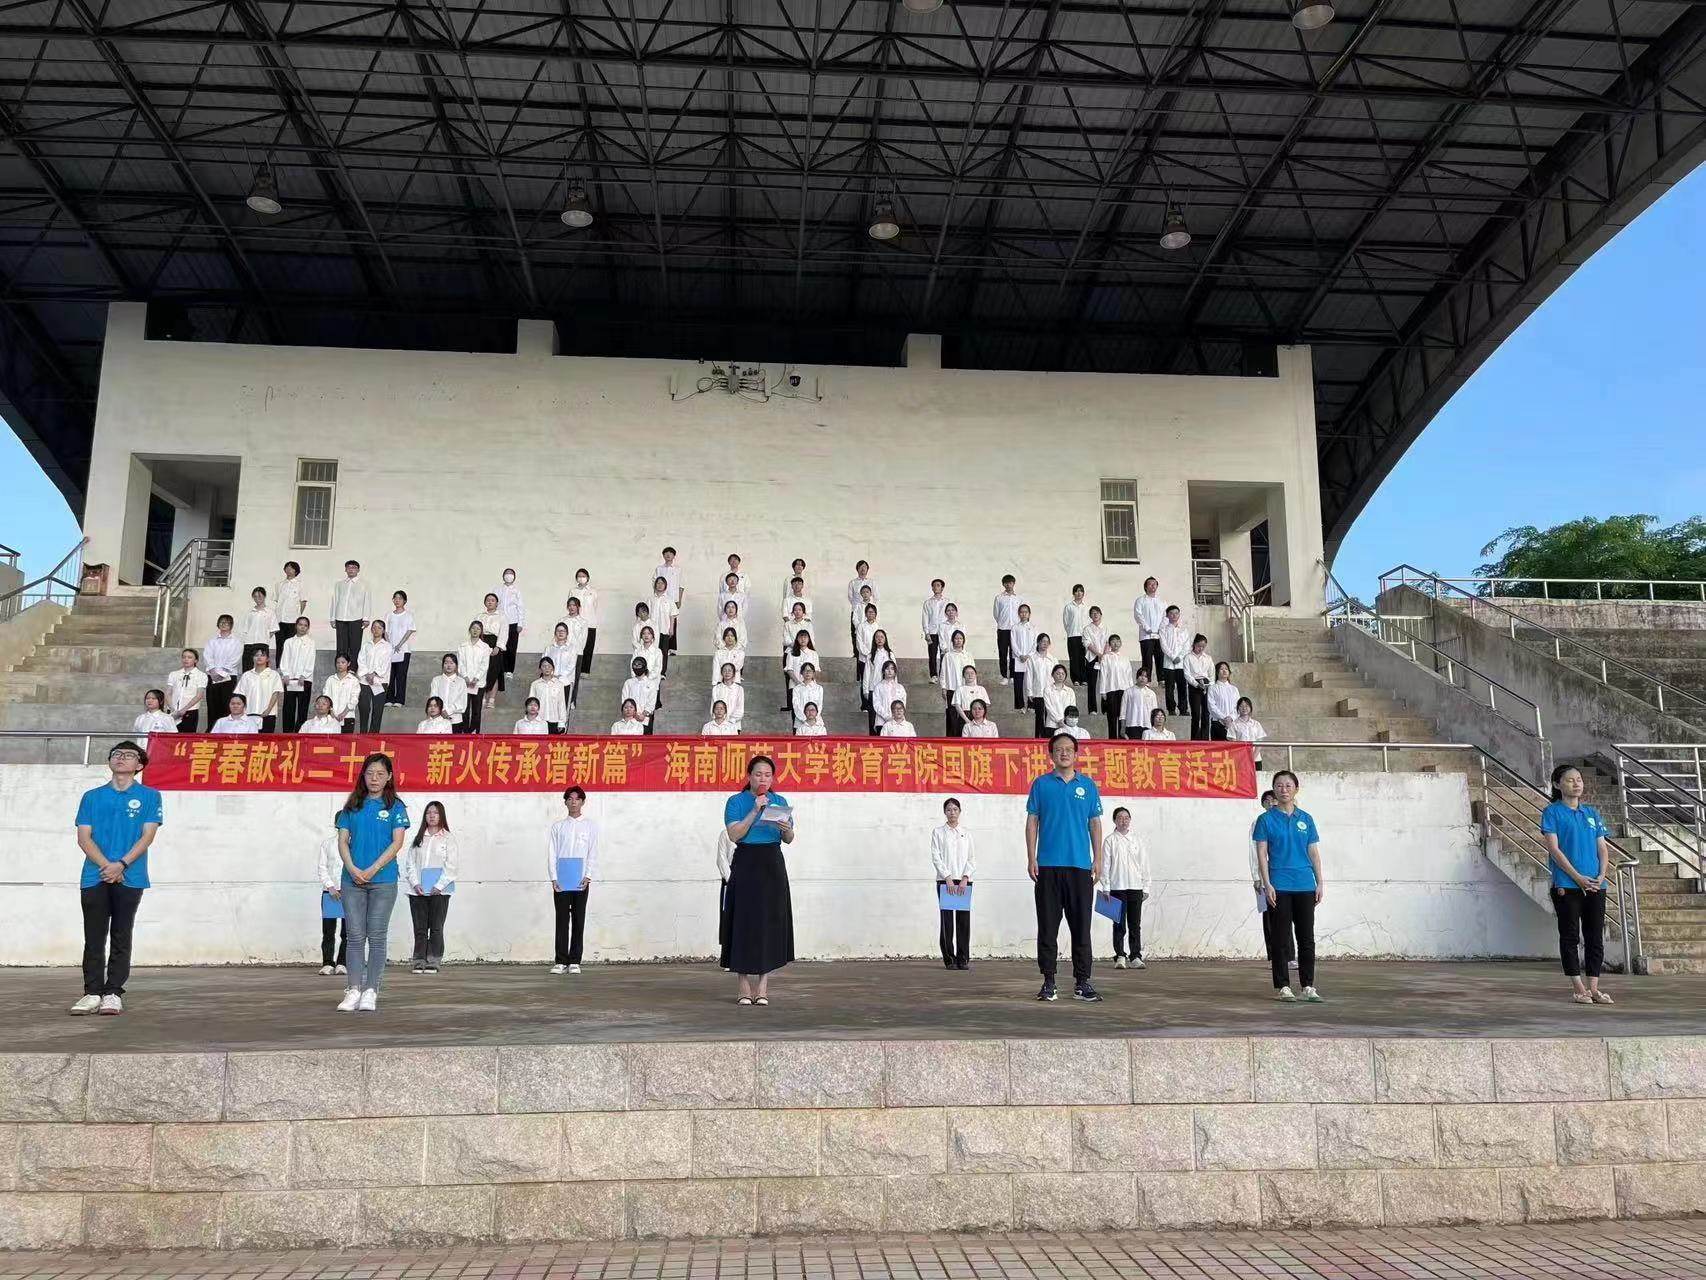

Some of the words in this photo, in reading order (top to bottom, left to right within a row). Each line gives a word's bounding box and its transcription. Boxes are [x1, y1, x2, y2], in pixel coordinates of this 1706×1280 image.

[664, 741, 1237, 791] 海南师大学教育学院国旗下讲主题教育活动
